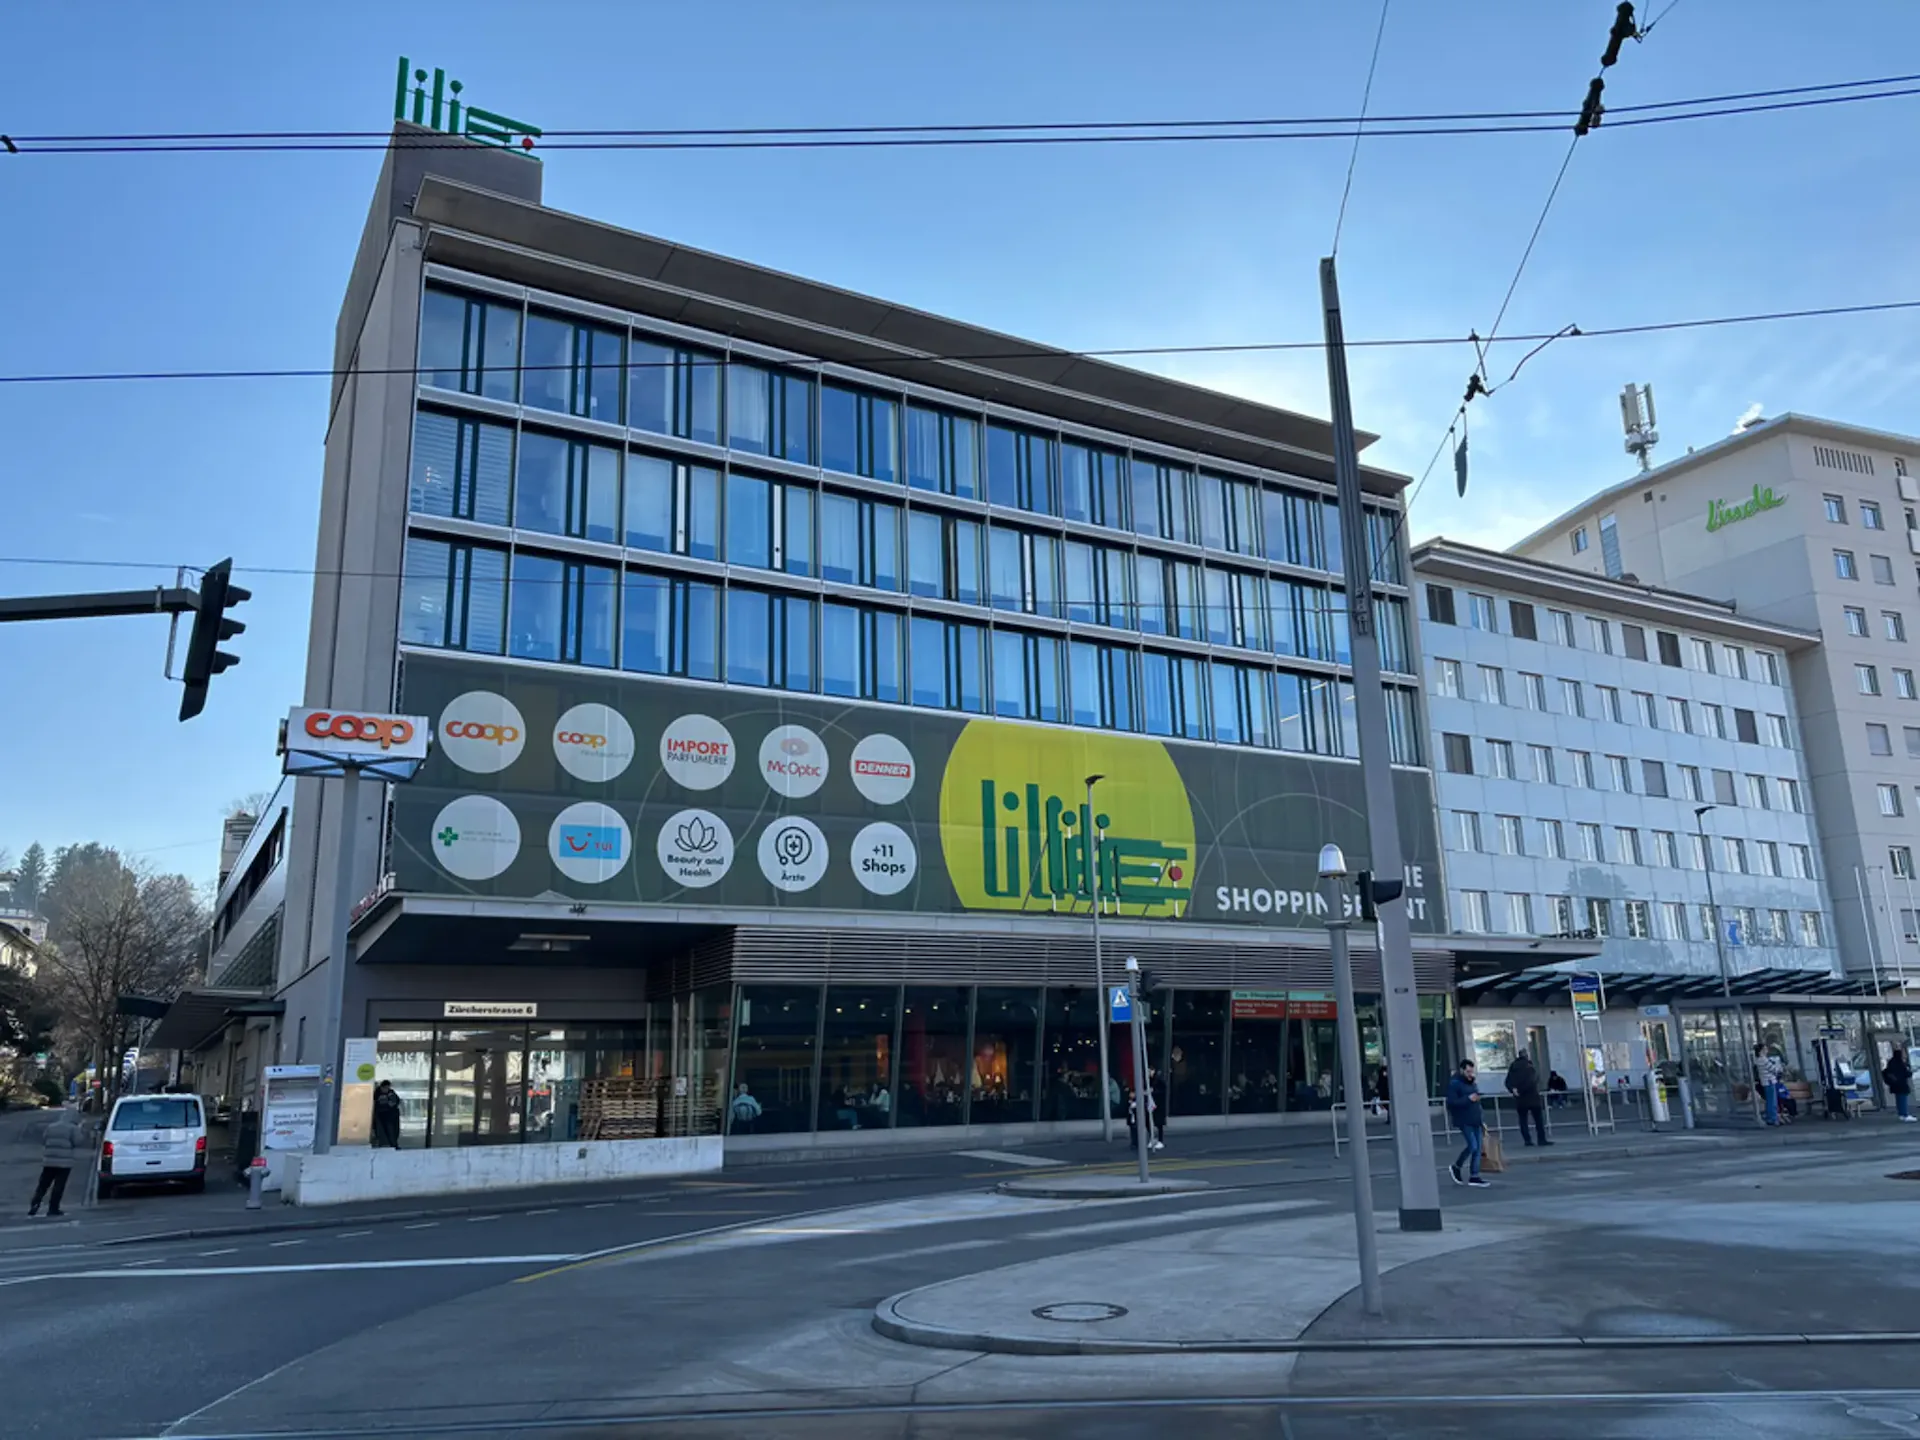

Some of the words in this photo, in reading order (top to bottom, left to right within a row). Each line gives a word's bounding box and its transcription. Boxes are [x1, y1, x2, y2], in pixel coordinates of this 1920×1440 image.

[305, 712, 413, 749] coop
[446, 720, 519, 746] coop
[558, 731, 606, 748] coop
[667, 738, 729, 756] IMPORT
[857, 762, 909, 776] DENNER
[595, 842, 613, 851] TUI
[873, 844, 894, 858] +11
[667, 854, 702, 867] Beauty
[704, 856, 725, 865] and
[862, 858, 906, 877] Shops
[680, 868, 712, 877] Health
[780, 869, 806, 882] Ärzte
